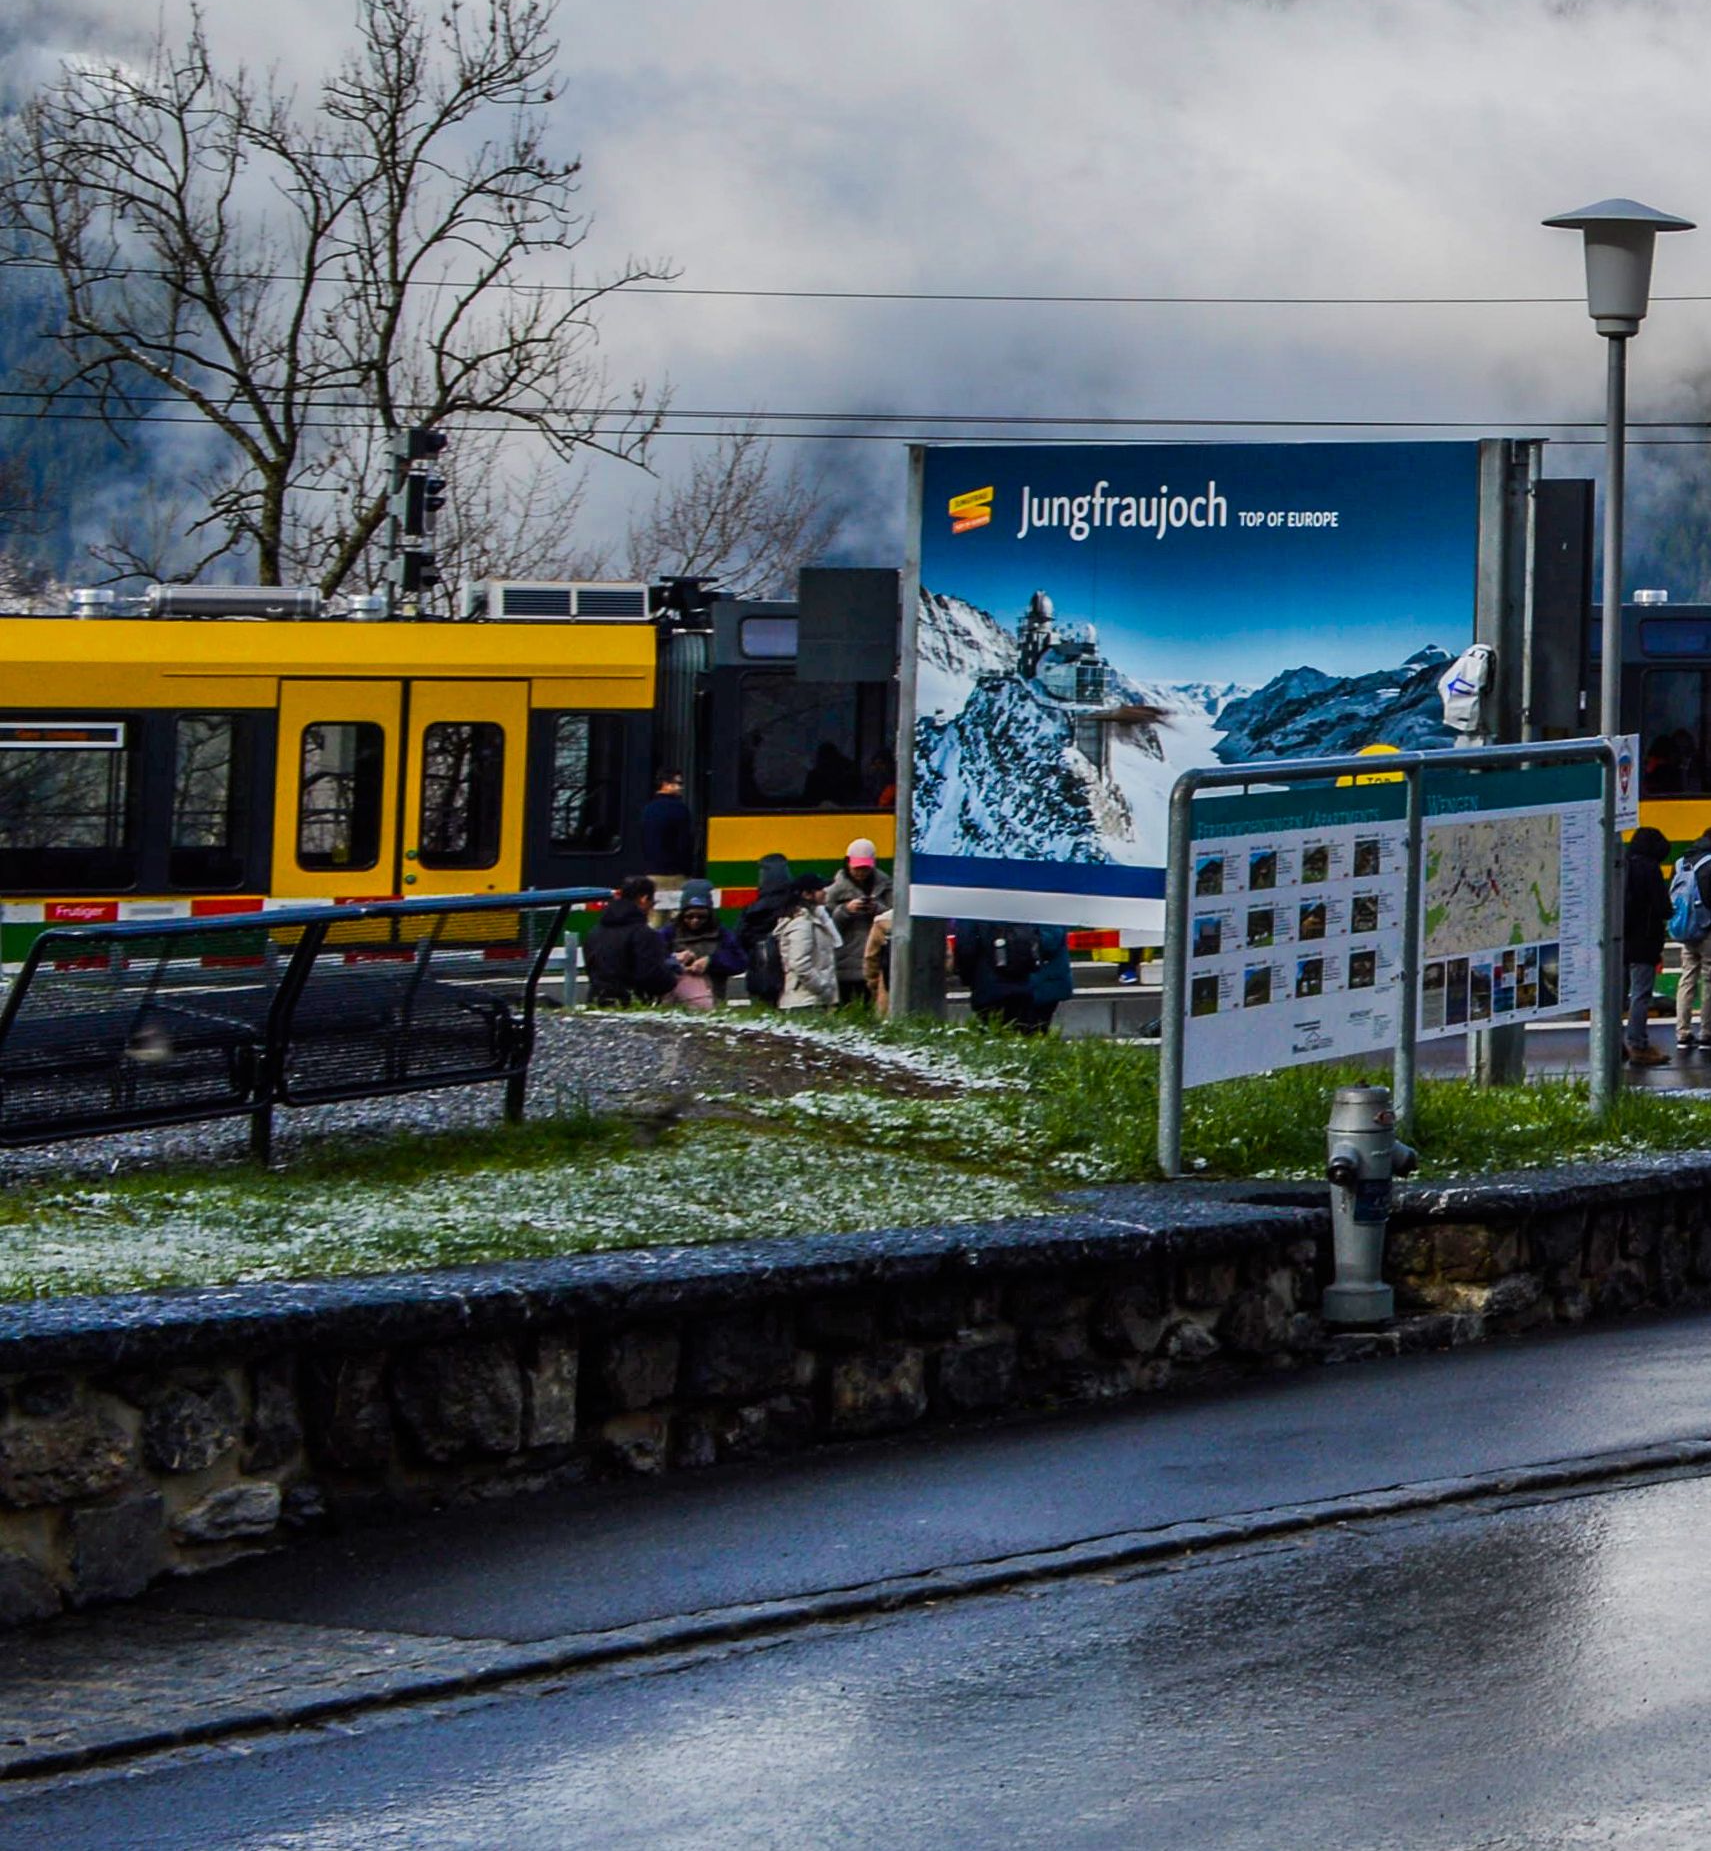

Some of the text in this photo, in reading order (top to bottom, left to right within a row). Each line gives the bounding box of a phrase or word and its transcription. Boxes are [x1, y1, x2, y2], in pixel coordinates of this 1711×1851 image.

[1016, 480, 1340, 542] Jungfraujoch TOP OF EUROPE
[55, 904, 107, 919] Frutiger
